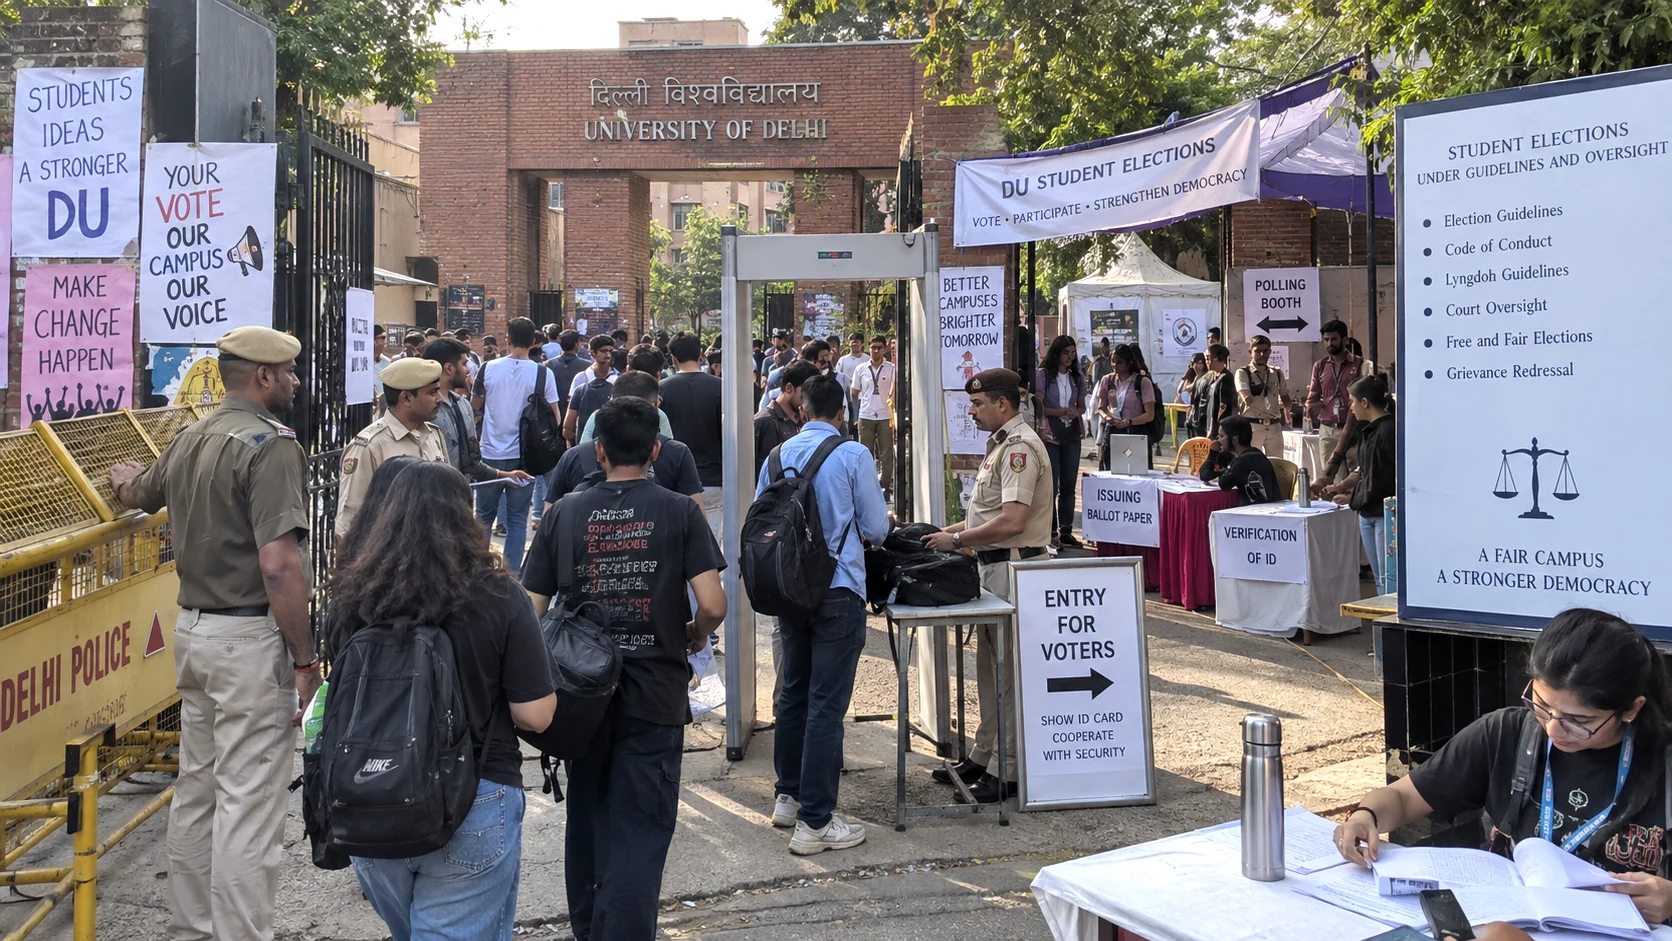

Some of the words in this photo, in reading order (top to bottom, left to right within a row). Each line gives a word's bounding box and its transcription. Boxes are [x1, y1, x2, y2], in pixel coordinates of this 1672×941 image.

[28, 76, 132, 113] STUDENTS
[588, 77, 650, 106] दिल्ली
[662, 76, 821, 106] विश्वविद्यालय
[43, 116, 104, 147] IDEAS
[584, 119, 716, 141] UNIVERSITY
[725, 119, 753, 140] OF
[762, 119, 828, 140] DELHI
[1448, 137, 1523, 160] STUDENT
[1531, 122, 1629, 150] ELECTIONS
[19, 161, 32, 184] A
[40, 152, 128, 180] STRONGER
[1001, 177, 1029, 200] DU
[1037, 161, 1116, 190] STUDENT
[1122, 137, 1216, 174] ELECTIONS
[1417, 169, 1460, 185] UNDER
[1465, 158, 1545, 180] GUIDELINES
[1549, 153, 1580, 169] AND
[1585, 141, 1669, 164] OVERSIGHT
[164, 162, 220, 189] YOUR
[155, 188, 224, 223] VOTE
[972, 215, 1001, 228] VOTE
[1013, 203, 1082, 224] PARTICIPATE
[1094, 186, 1169, 211] STRENGTHEN
[1173, 167, 1248, 195] DEMOCRACY
[48, 187, 109, 240] DU
[1444, 212, 1492, 228] Election
[1497, 205, 1563, 222] Guidelines
[166, 223, 211, 249] OUR
[1445, 240, 1476, 256] Code
[1480, 239, 1494, 253] of
[1498, 235, 1553, 251] Conduct
[149, 248, 224, 276] CAMPUS
[53, 275, 107, 299] MAKE
[943, 275, 990, 292] BETTER
[1255, 279, 1306, 292] POLLING
[1445, 269, 1496, 288] Lyngdoh
[1502, 264, 1569, 281] Guidelines
[166, 275, 211, 300] OUR
[940, 294, 998, 310] CAMPUSES
[1261, 297, 1302, 309] BOOTH
[1446, 301, 1481, 316] Court
[1486, 298, 1548, 315] Oversight
[34, 308, 121, 338] CHANGE
[163, 298, 228, 330] VOICE
[940, 313, 996, 329] BRIGHTER
[1446, 335, 1472, 348] Free
[1477, 333, 1499, 347] and
[1504, 332, 1528, 346] Fair
[1534, 330, 1593, 345] Elections
[39, 347, 114, 374] HAPPEN
[1447, 364, 1508, 380] Grievance
[1512, 362, 1574, 378] Redressal
[1097, 489, 1142, 503] ISSUING
[1087, 508, 1120, 521] BALLOT
[1123, 511, 1153, 524] PAPER
[1224, 526, 1297, 542] VERIFICATION
[1247, 552, 1262, 564] OF
[1265, 553, 1277, 565] ID
[1478, 548, 1489, 562] A
[1495, 548, 1529, 564] FAIR
[1535, 550, 1604, 568] CAMPUS
[1437, 569, 1447, 584] A
[1453, 569, 1537, 589] STRONGER
[1543, 575, 1651, 596] DEMOCRACY
[1045, 588, 1106, 607] ENTRY
[1057, 615, 1096, 634] FOR
[1041, 640, 1115, 660] VOTERS
[1, 654, 61, 732] DELHI
[71, 620, 131, 694] POLICE
[1041, 714, 1073, 726] SHOW
[1078, 713, 1090, 724] ID
[1094, 712, 1123, 723] CARD
[1052, 730, 1114, 743] COOPERATE
[362, 758, 393, 772] NIKE
[1043, 750, 1071, 761] WITH
[1076, 747, 1126, 759] SECURITY
